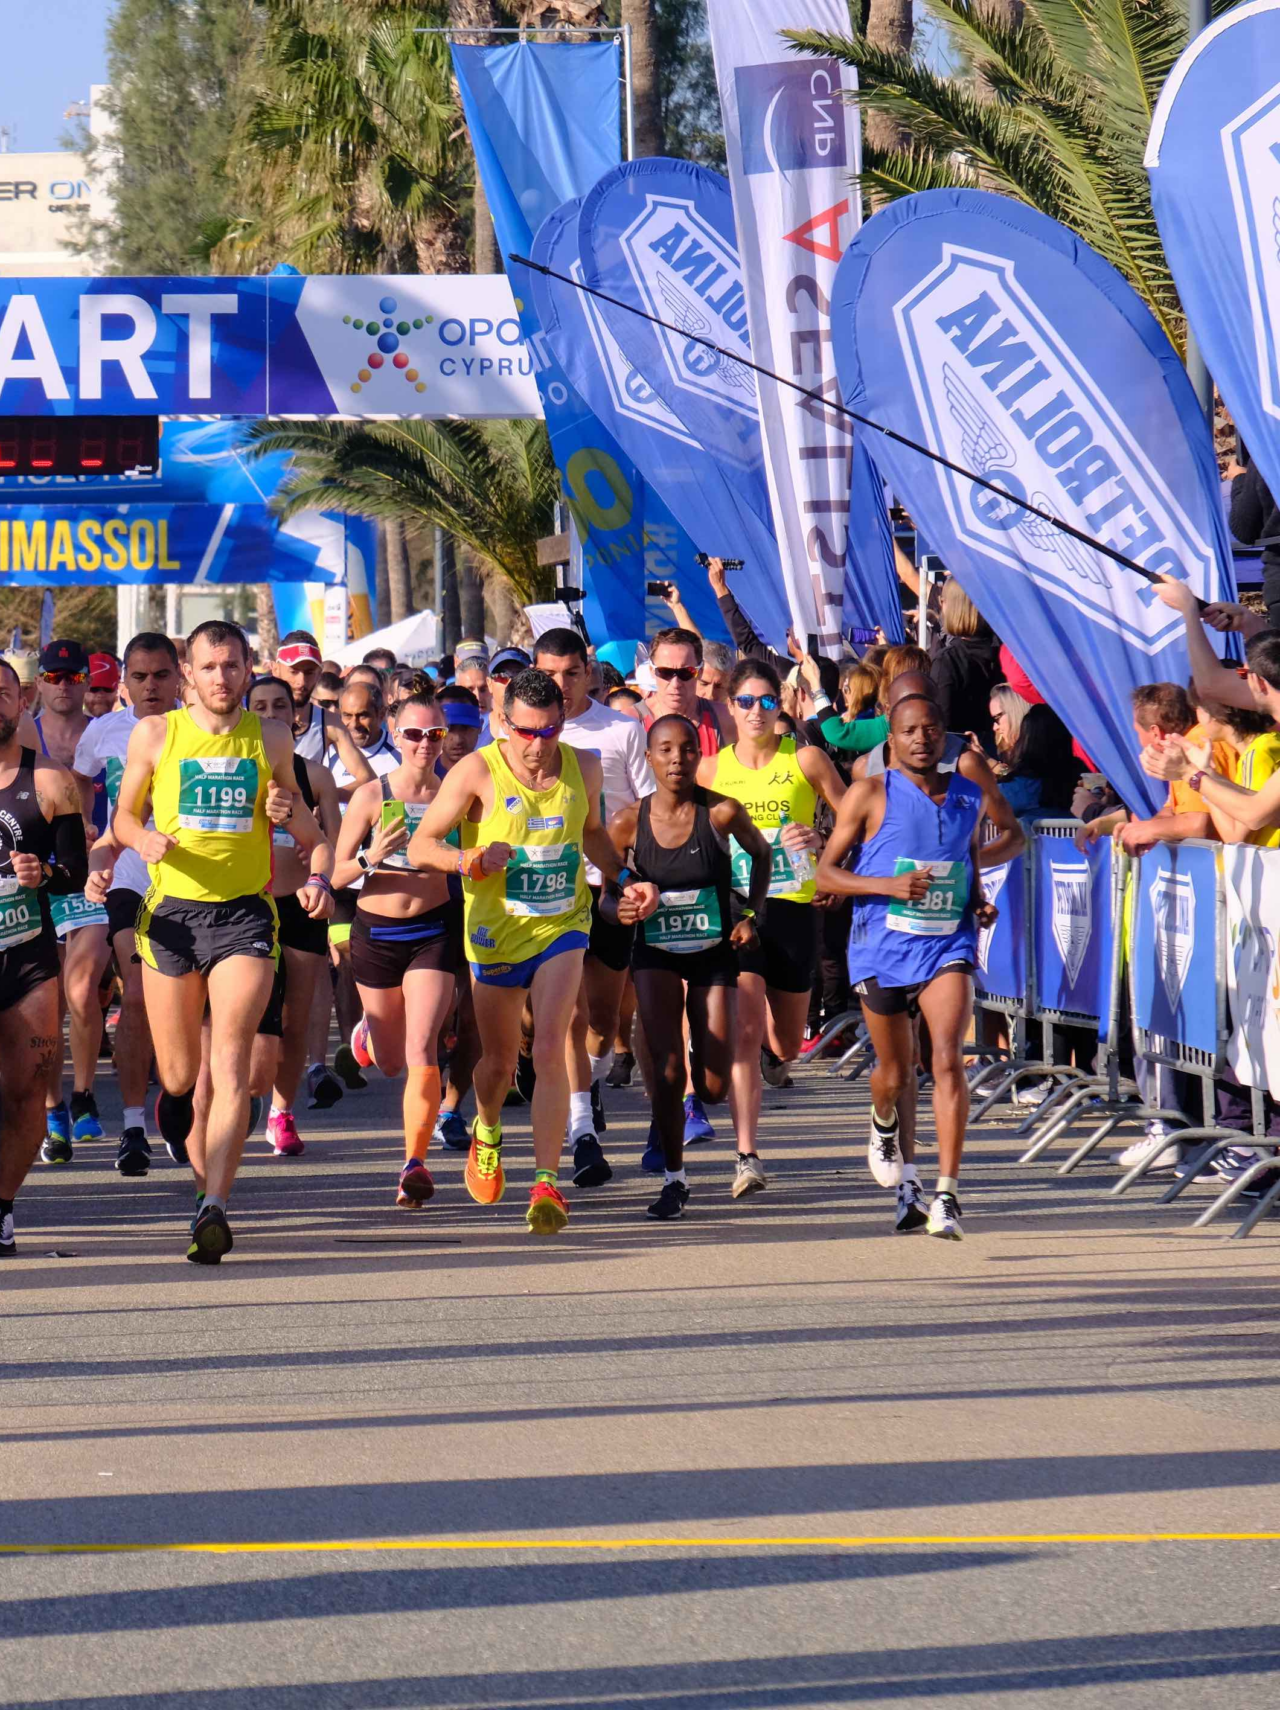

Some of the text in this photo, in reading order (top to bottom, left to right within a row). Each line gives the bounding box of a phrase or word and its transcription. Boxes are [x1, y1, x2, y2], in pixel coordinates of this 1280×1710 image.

[50, 180, 92, 200] ON
[440, 357, 533, 377] CYPRU
[194, 786, 247, 808] 1199
[744, 800, 791, 812] PHOS
[0, 810, 23, 841] CENTRE
[520, 872, 567, 893] 1798
[657, 913, 709, 933] 1970
